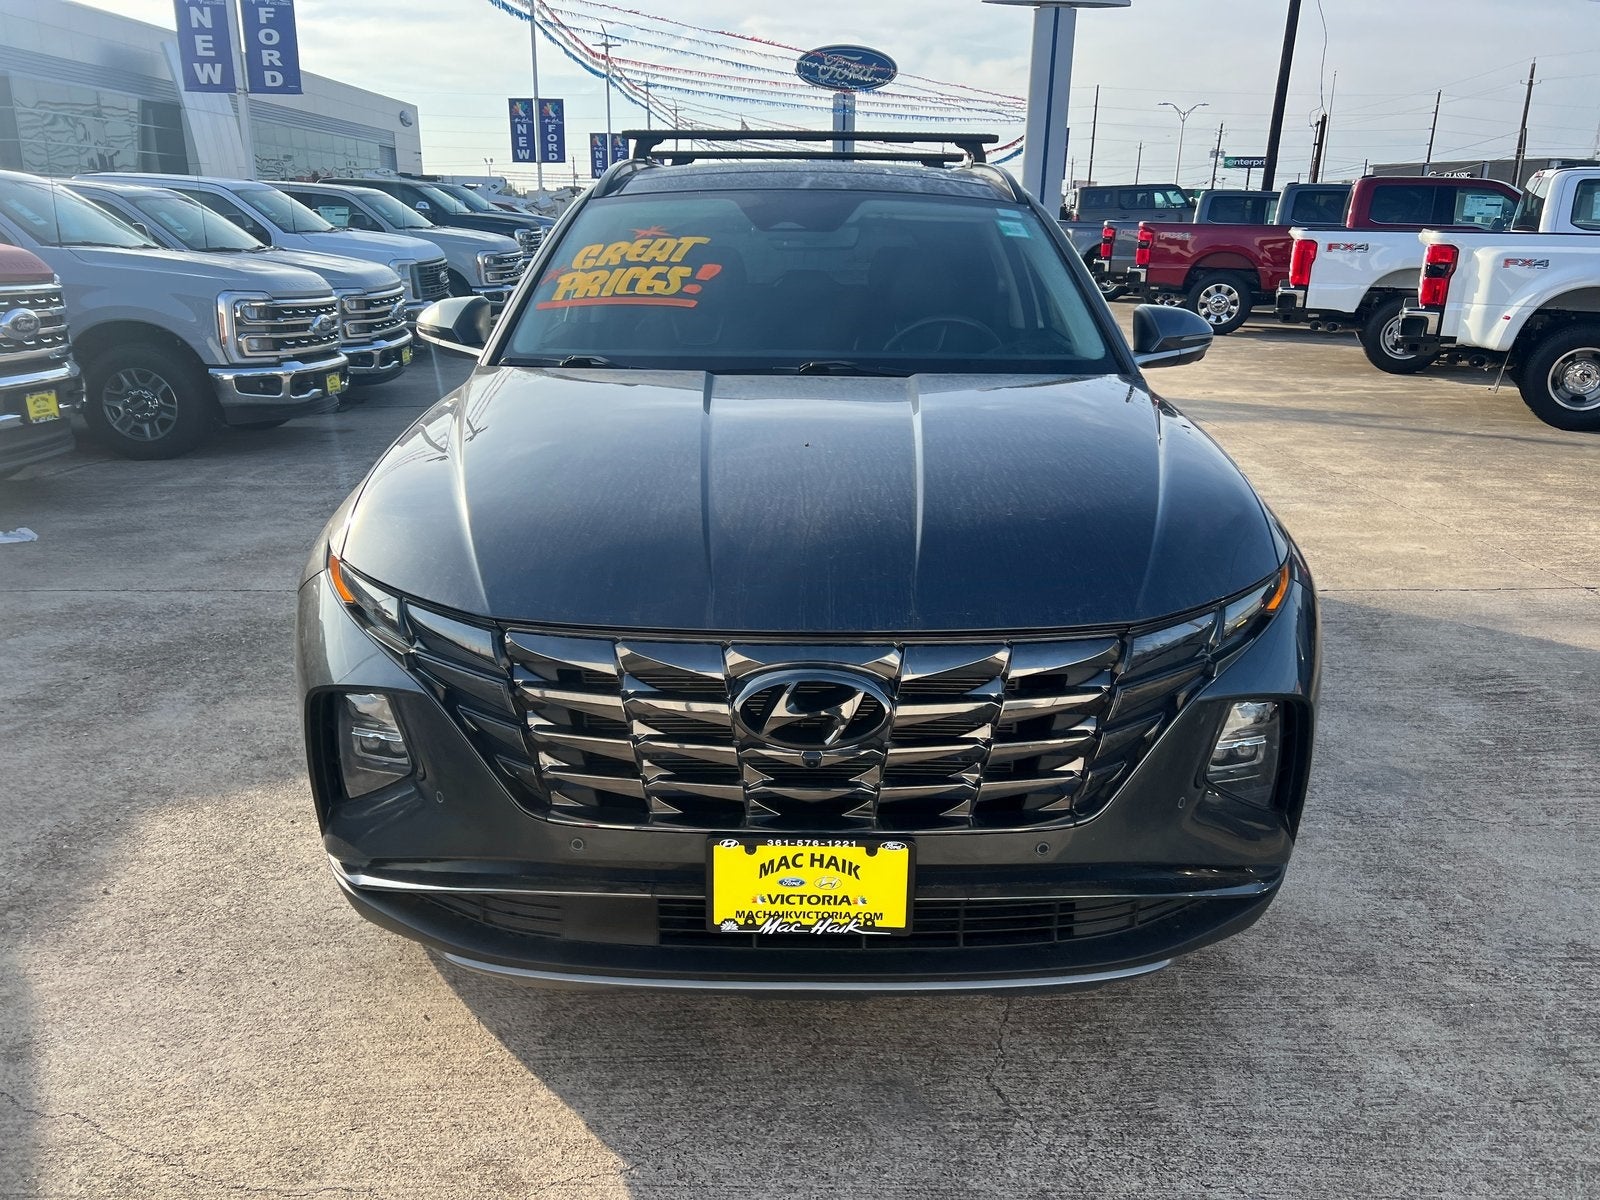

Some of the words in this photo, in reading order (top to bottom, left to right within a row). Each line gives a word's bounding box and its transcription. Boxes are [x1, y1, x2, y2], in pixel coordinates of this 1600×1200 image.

[189, 6, 222, 85] NEW
[257, 7, 284, 87] FORD
[817, 53, 877, 80] Ford
[517, 123, 531, 161] NEW
[547, 123, 559, 161] FORD
[595, 151, 605, 177] NEW
[1225, 158, 1266, 167] enterpri
[572, 237, 711, 269] GREAT
[1326, 242, 1369, 253] FX4
[1503, 258, 1550, 269] FX4
[767, 839, 857, 848] 361-576-1221
[759, 853, 804, 879] MAC
[810, 853, 860, 880] HAIK
[767, 894, 852, 906] VICTORIA
[735, 910, 883, 921] MACHAIKVICTORIACOM
[759, 916, 803, 935] Mac
[810, 917, 874, 935] Haik
